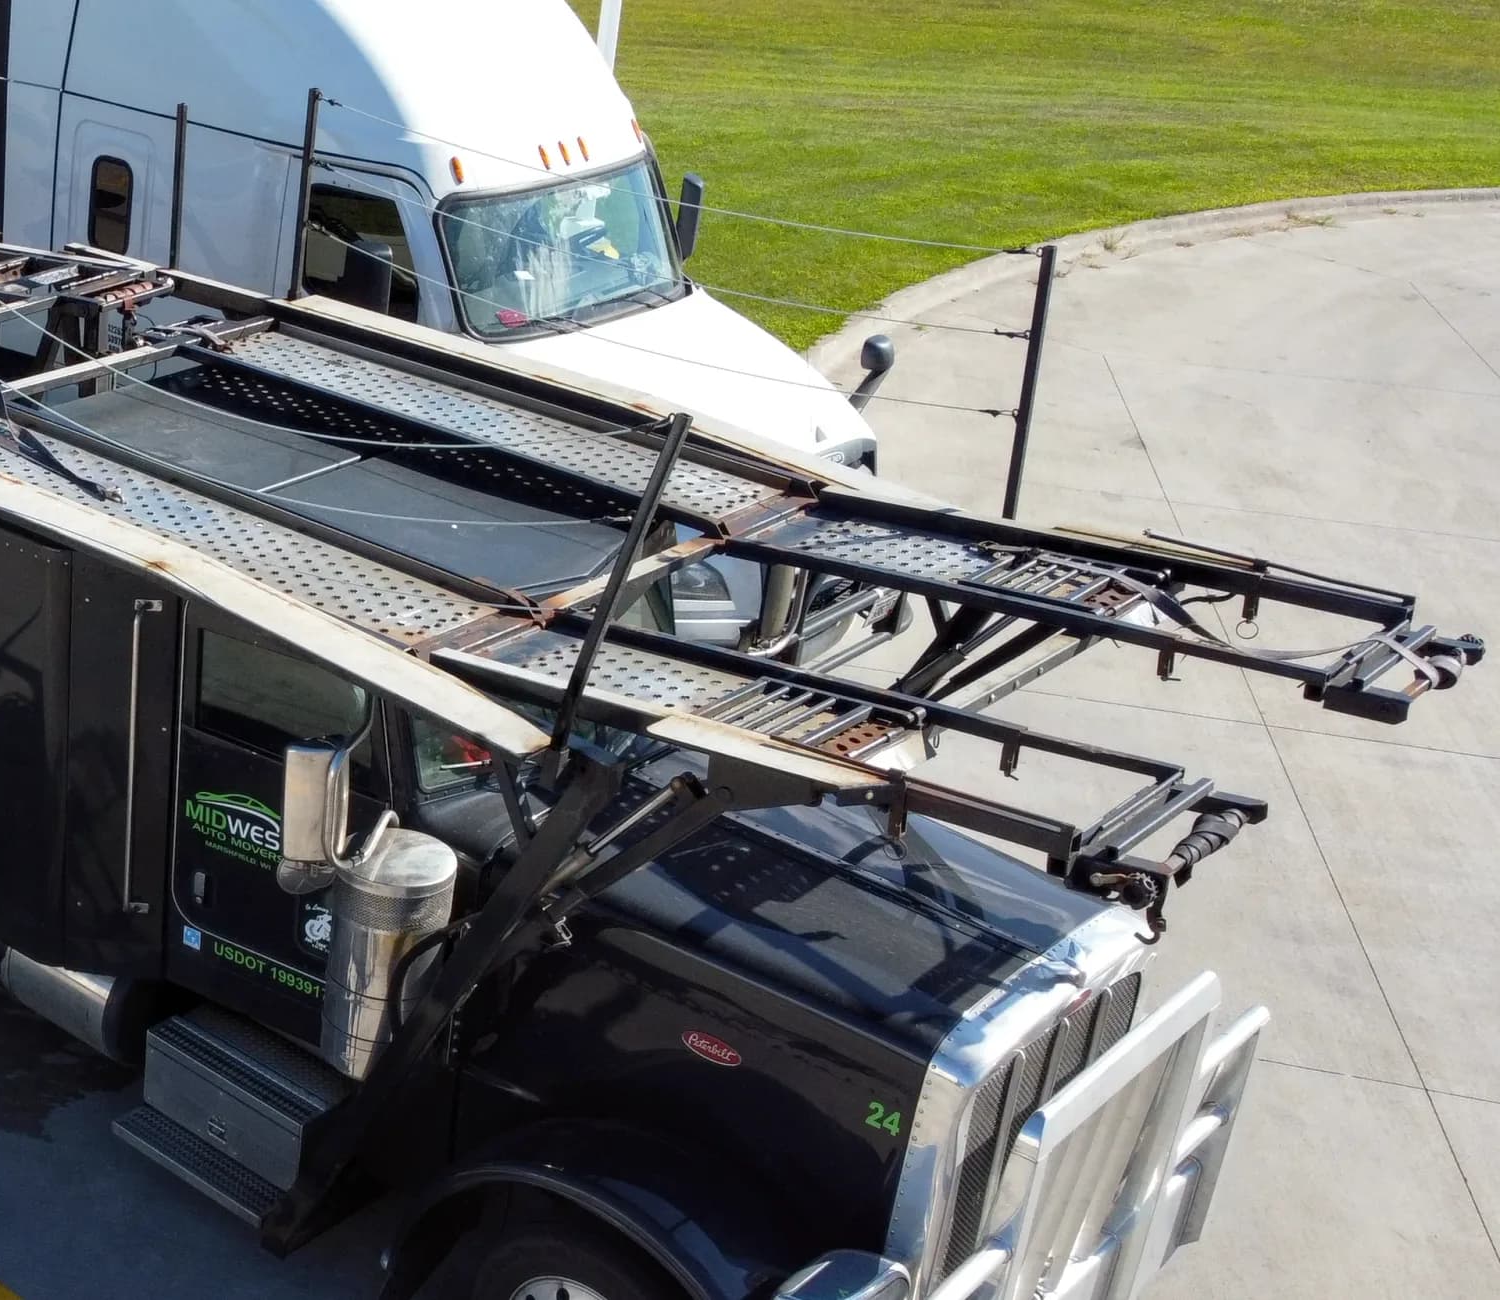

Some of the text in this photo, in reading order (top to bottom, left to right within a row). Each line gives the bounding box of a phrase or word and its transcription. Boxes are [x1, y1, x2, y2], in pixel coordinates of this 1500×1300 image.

[186, 799, 280, 851] MIDWES
[192, 823, 284, 864] AUTO MOVERS
[214, 942, 266, 974] USDOT
[688, 1033, 737, 1061] Peterbilt
[865, 1102, 900, 1136] 24
